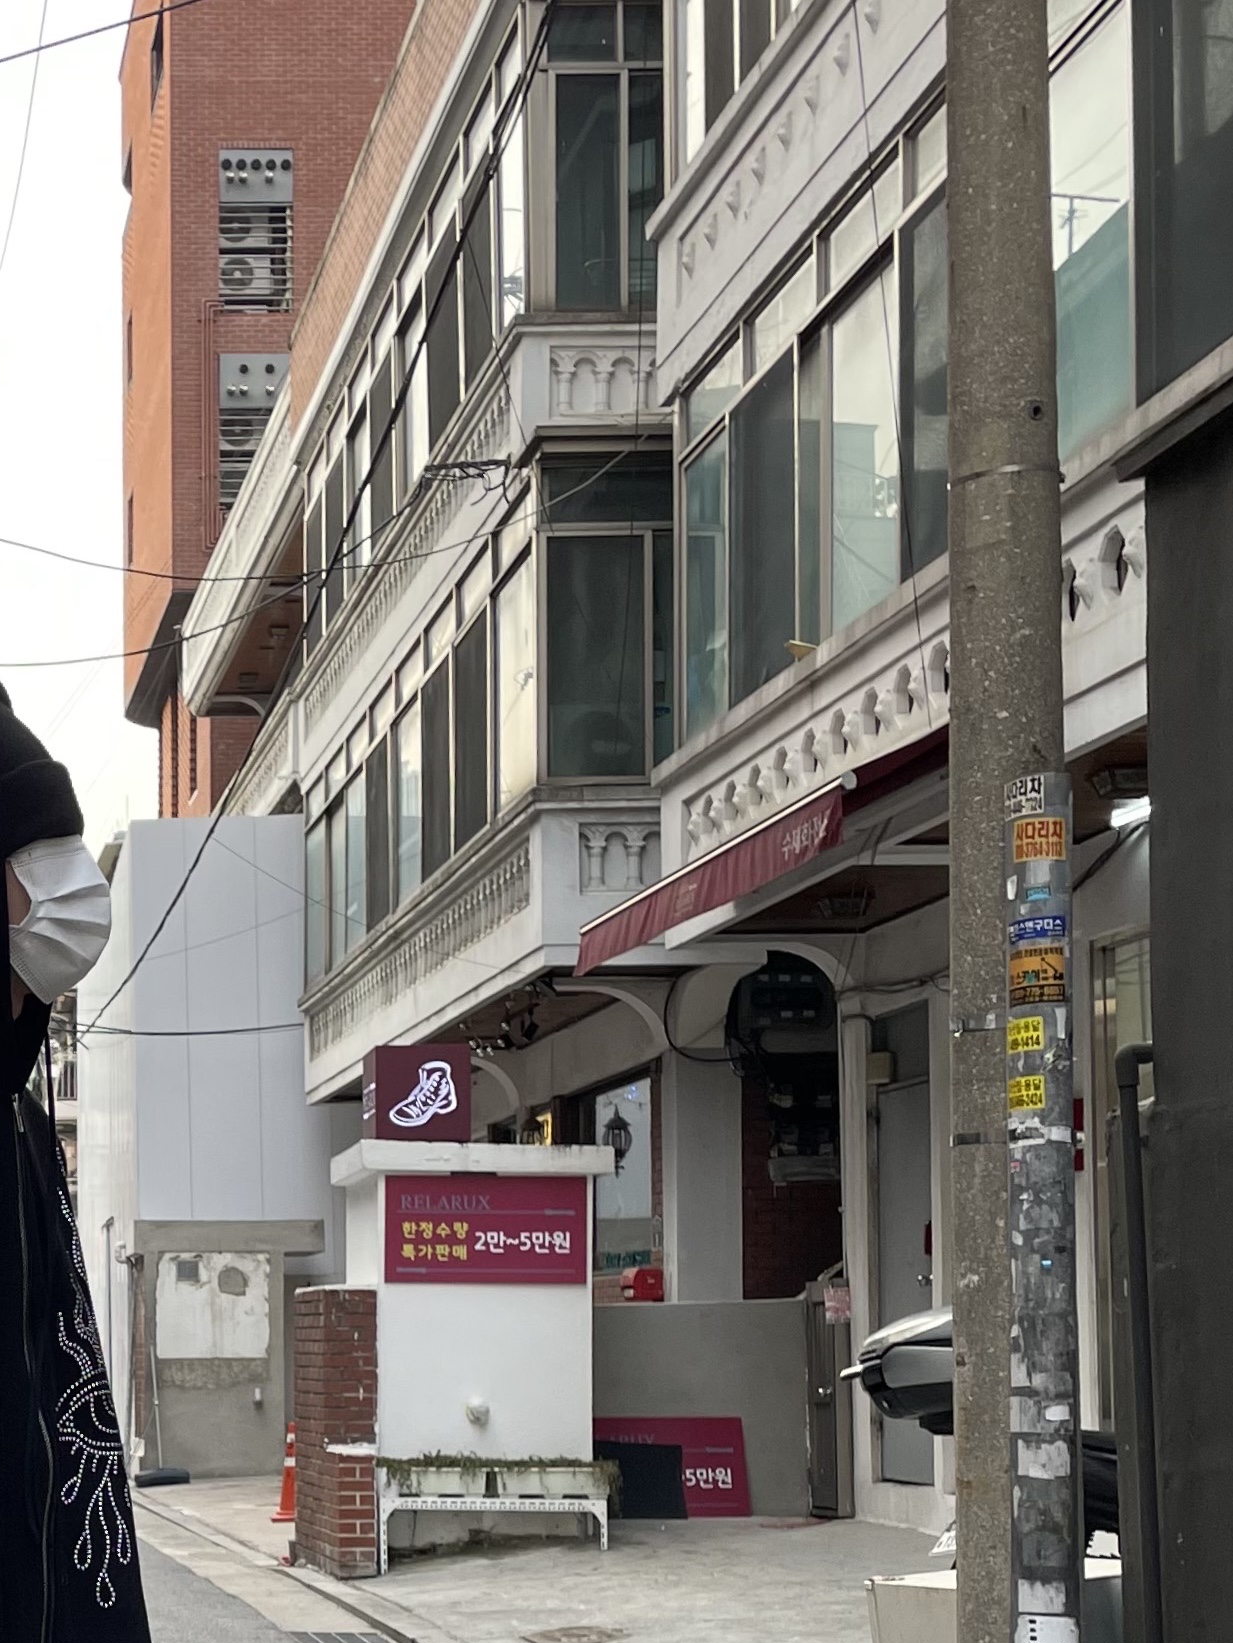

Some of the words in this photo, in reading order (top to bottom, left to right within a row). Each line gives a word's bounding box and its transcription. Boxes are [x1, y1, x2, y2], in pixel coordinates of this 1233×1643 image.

[400, 1194, 492, 1211] RELARUX
[401, 1221, 469, 1239] 한정수량
[473, 1231, 571, 1254] 2만~5만원
[400, 1243, 468, 1262] 특가판매
[682, 1467, 733, 1489] 5만원
